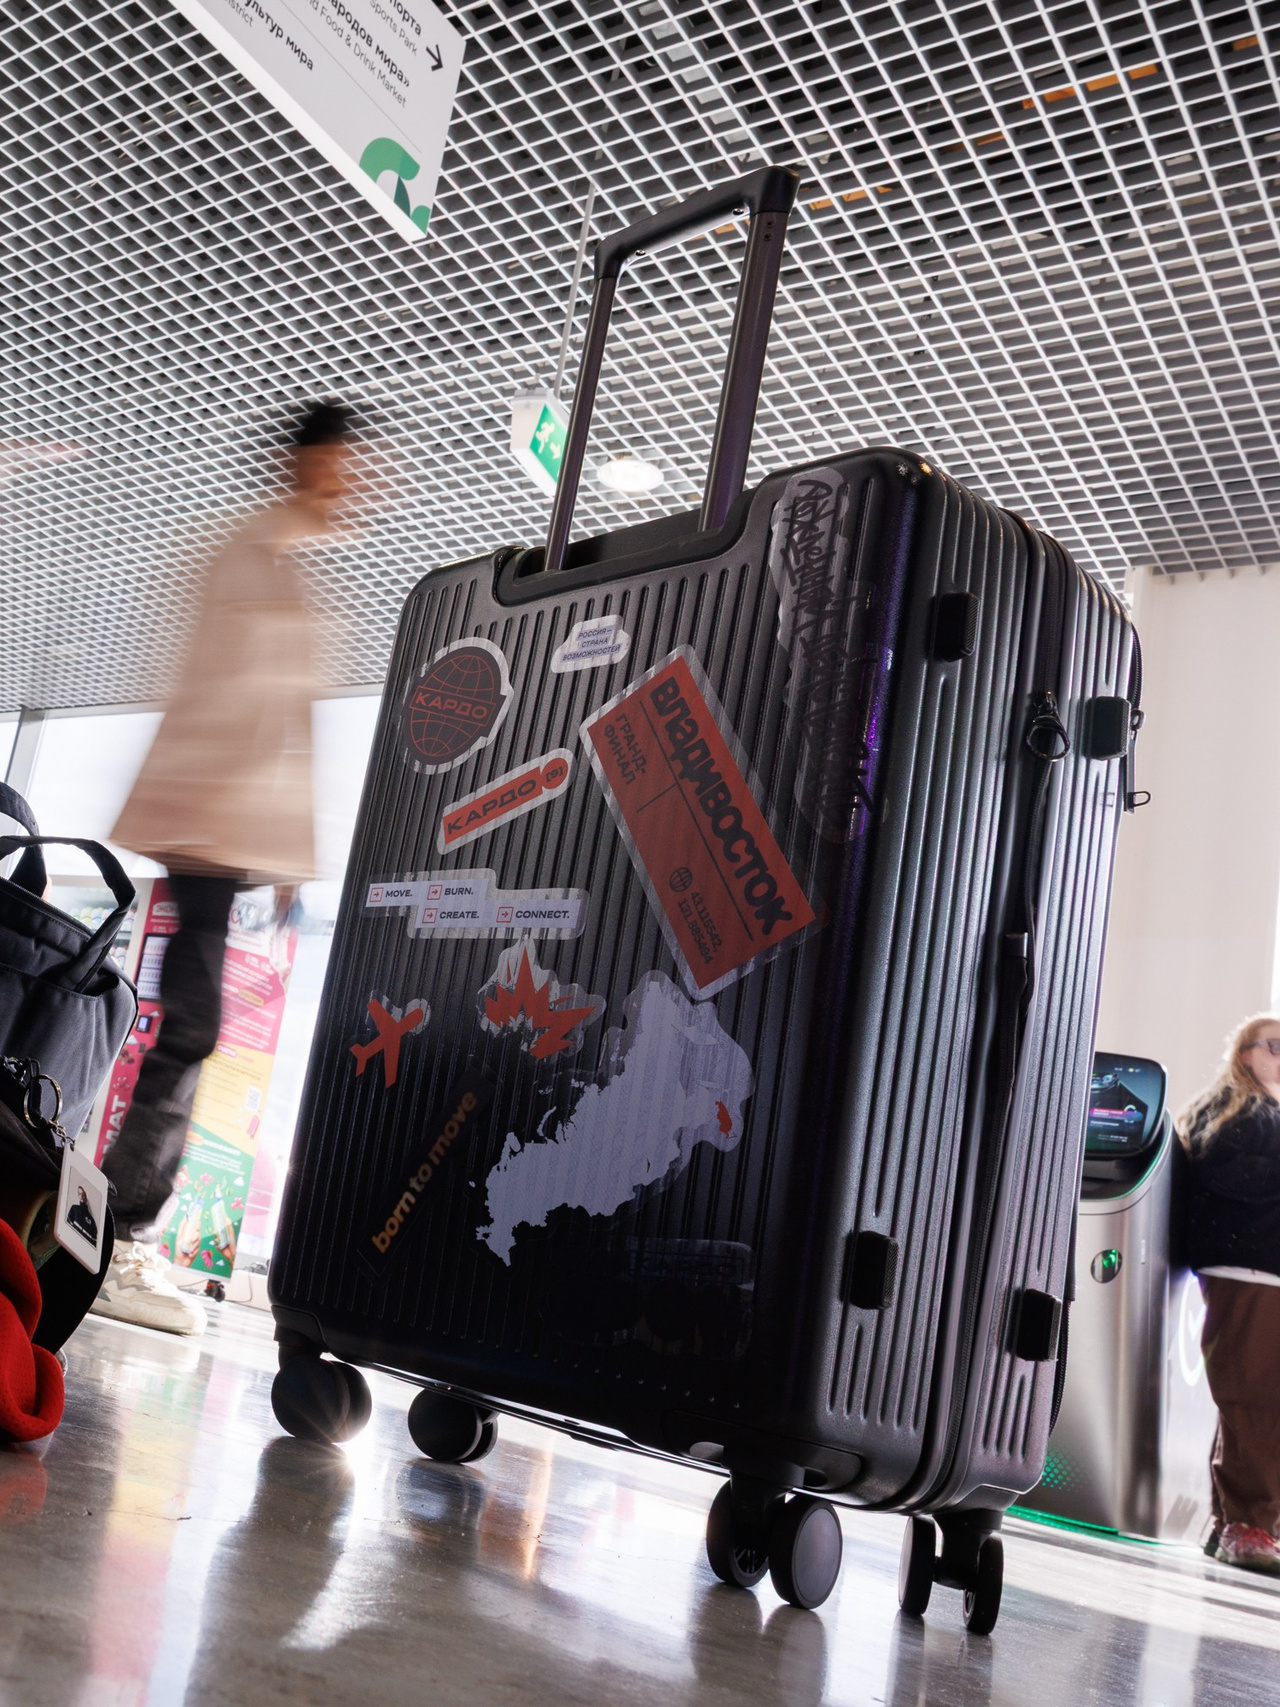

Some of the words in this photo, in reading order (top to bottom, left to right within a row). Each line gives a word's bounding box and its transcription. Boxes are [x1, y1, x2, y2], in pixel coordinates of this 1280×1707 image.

[286, 35, 314, 71] мира
[320, 6, 344, 38] Food
[345, 34, 352, 47] &
[353, 43, 376, 75] Drink
[377, 70, 406, 108] Market
[329, 0, 373, 47] ародов
[375, 44, 410, 87] мира»
[399, 28, 419, 56] Park
[577, 628, 607, 639] РОССИЯ
[581, 638, 608, 648] СТРАНА
[563, 643, 622, 661] ВОЗМОЖНОСТЕЙ
[415, 692, 488, 719] КАРДО
[604, 724, 636, 785] ФИНАЛ
[616, 714, 647, 774] ГРАНД-
[447, 779, 537, 835] КАРДО
[546, 767, 564, 783] [9]
[385, 889, 413, 898] MOVE.
[444, 886, 474, 896] BURN.
[439, 911, 480, 919] CREATE.
[515, 910, 570, 919] CONNECT.
[372, 1191, 417, 1253] born
[409, 1163, 433, 1192] to
[428, 1092, 477, 1165] move
